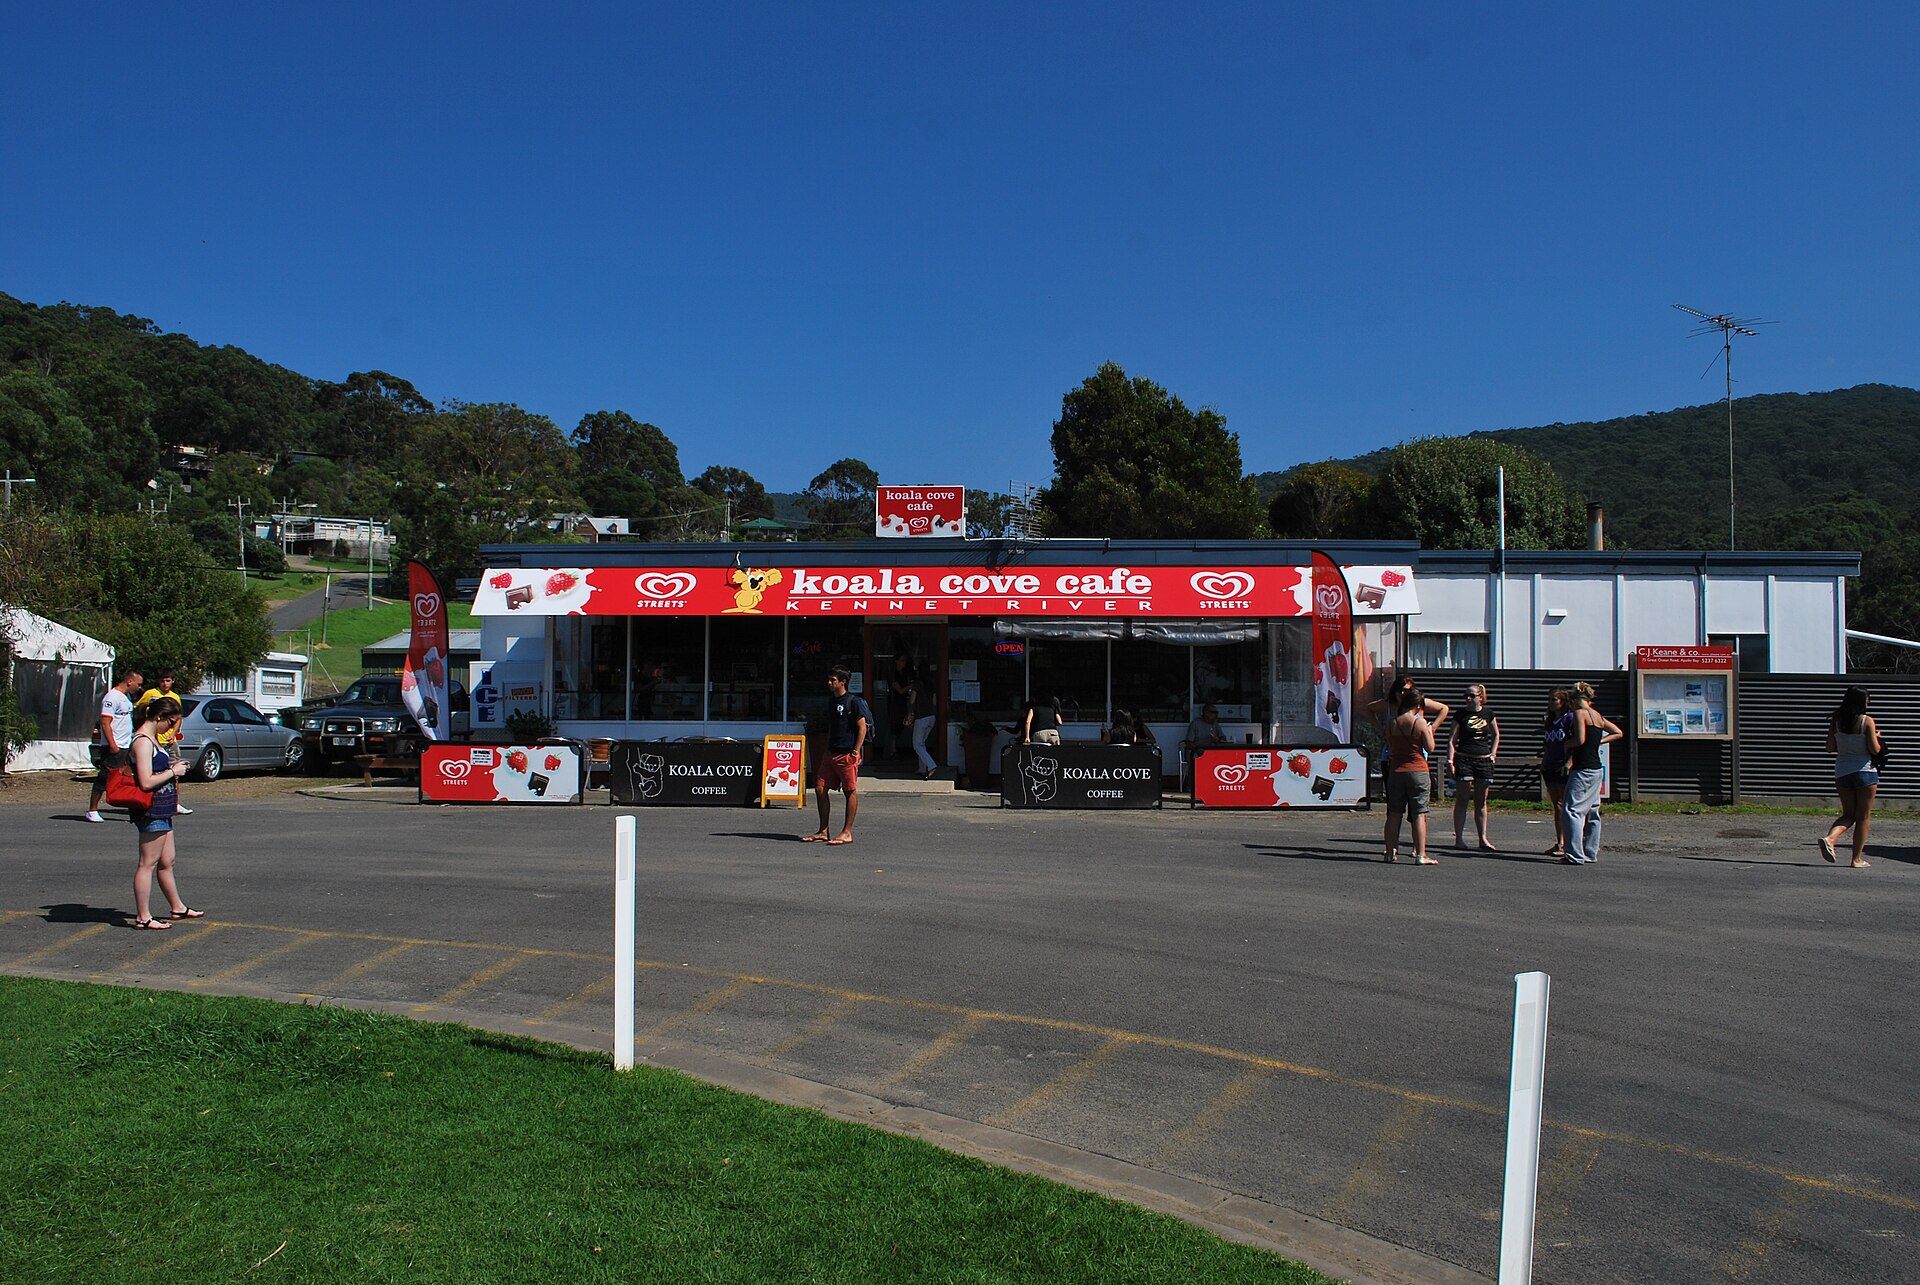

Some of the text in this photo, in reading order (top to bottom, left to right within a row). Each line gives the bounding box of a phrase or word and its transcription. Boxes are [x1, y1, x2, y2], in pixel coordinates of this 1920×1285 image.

[886, 490, 955, 500] koala cove
[907, 501, 934, 511] cafe
[789, 567, 1153, 594] koala cove cafe
[637, 600, 685, 608] STREETS
[786, 600, 1153, 611] KENNET RIVER
[1199, 601, 1249, 609] STREETS
[994, 643, 1025, 653] OPEN
[1638, 647, 1678, 658] C.J.Keane
[1679, 648, 1686, 656] &
[476, 668, 498, 722] ICE
[669, 764, 754, 777] KOALA COVE
[1062, 767, 1151, 779] KOALA COVE
[691, 787, 728, 795] COFFEE
[1086, 790, 1124, 798] COFFEE
